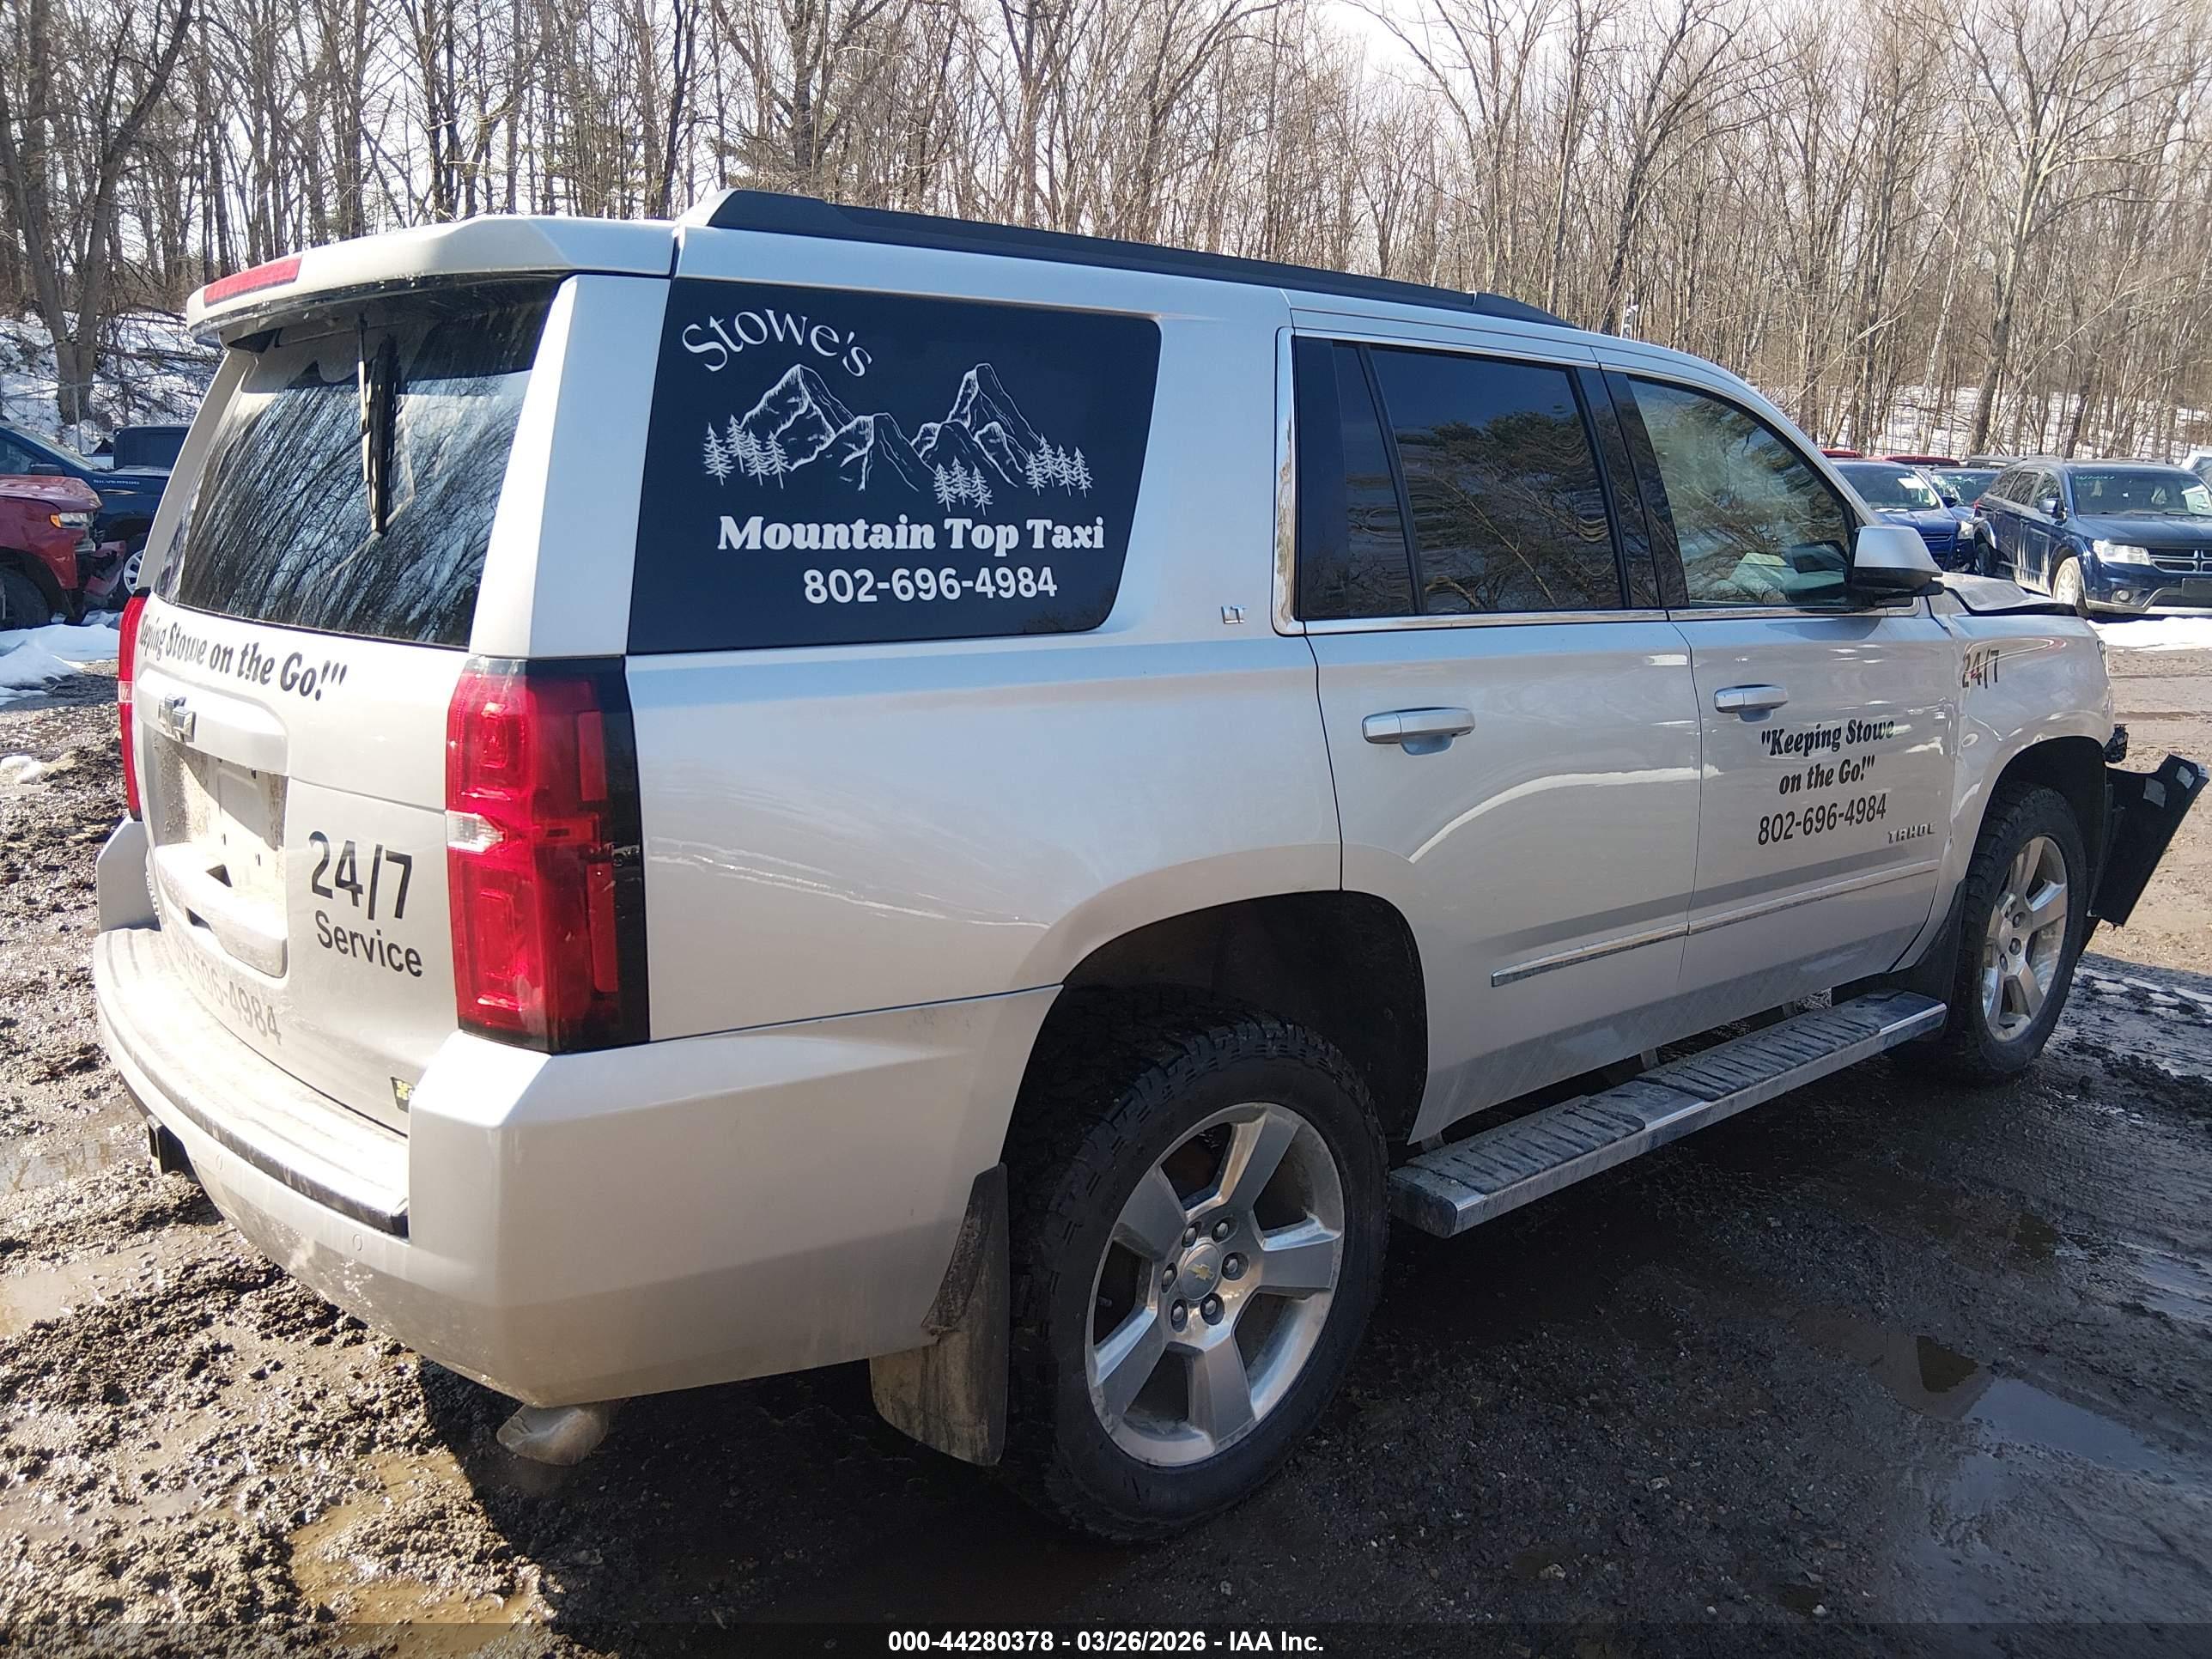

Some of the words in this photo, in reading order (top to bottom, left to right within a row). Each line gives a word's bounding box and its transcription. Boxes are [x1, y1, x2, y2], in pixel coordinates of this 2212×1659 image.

[681, 307, 873, 379] Stowe's
[716, 514, 936, 551] Mountain
[944, 517, 1020, 557] Top
[1026, 516, 1105, 550] Taxi
[803, 566, 1058, 605] 802-696-4984
[165, 621, 208, 665] Stowe
[209, 642, 234, 674] on
[237, 641, 276, 685] the
[279, 651, 348, 702] Go!"
[1962, 647, 2000, 690] 24/7
[1760, 723, 1842, 757] "Keeping
[1845, 719, 1894, 745] Stowe
[1778, 773, 1802, 795] on
[1807, 763, 1835, 790] the
[1838, 754, 1875, 785] Go!"
[1757, 793, 1887, 846] 802-696-4984
[307, 830, 413, 921] 24/7
[314, 908, 422, 978] Service
